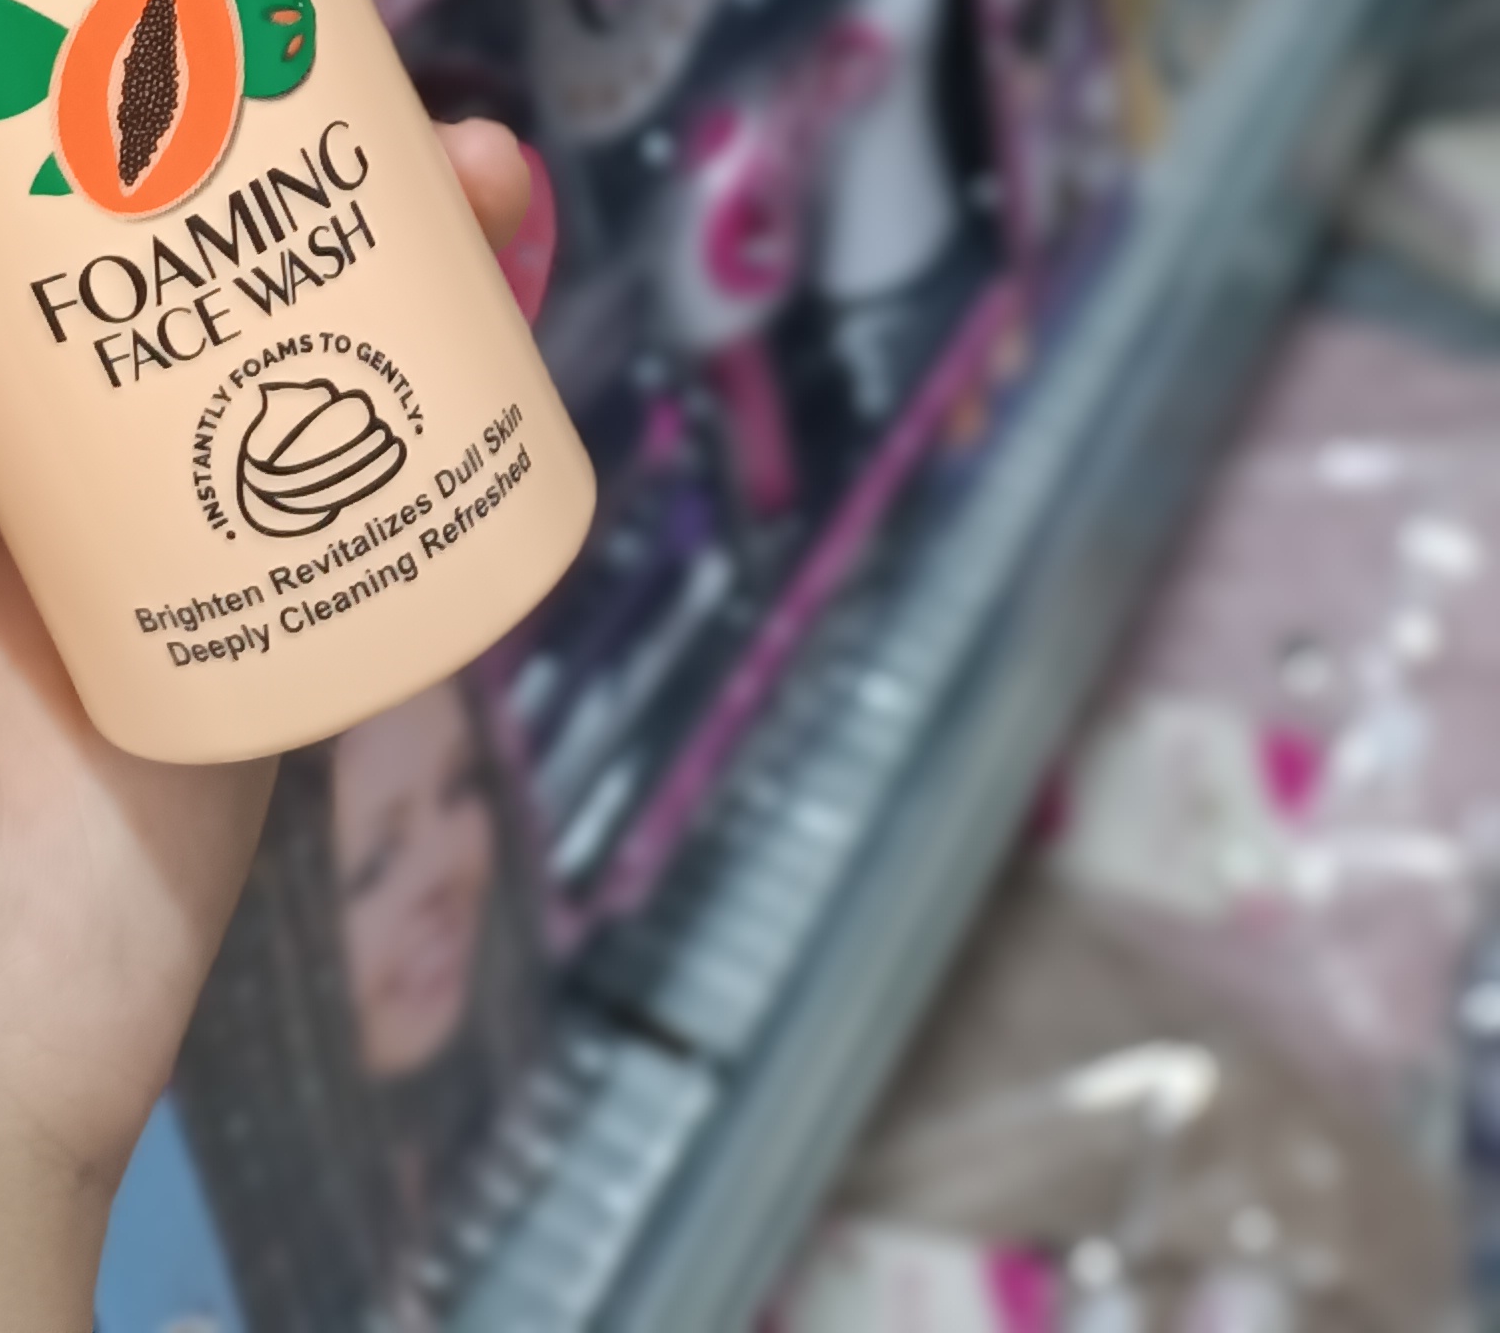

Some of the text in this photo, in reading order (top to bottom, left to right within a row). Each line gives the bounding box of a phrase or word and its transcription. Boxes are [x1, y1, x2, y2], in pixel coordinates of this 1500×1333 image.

[29, 119, 369, 344] FOAMING
[93, 199, 377, 389] FACE WASH
[134, 402, 525, 633] Brighten Revitalizes Dull Skin
[192, 332, 425, 531] INSTANTLY FOAMS TO GENTLY
[165, 441, 534, 668] Deeply Cleaning Refreshed
